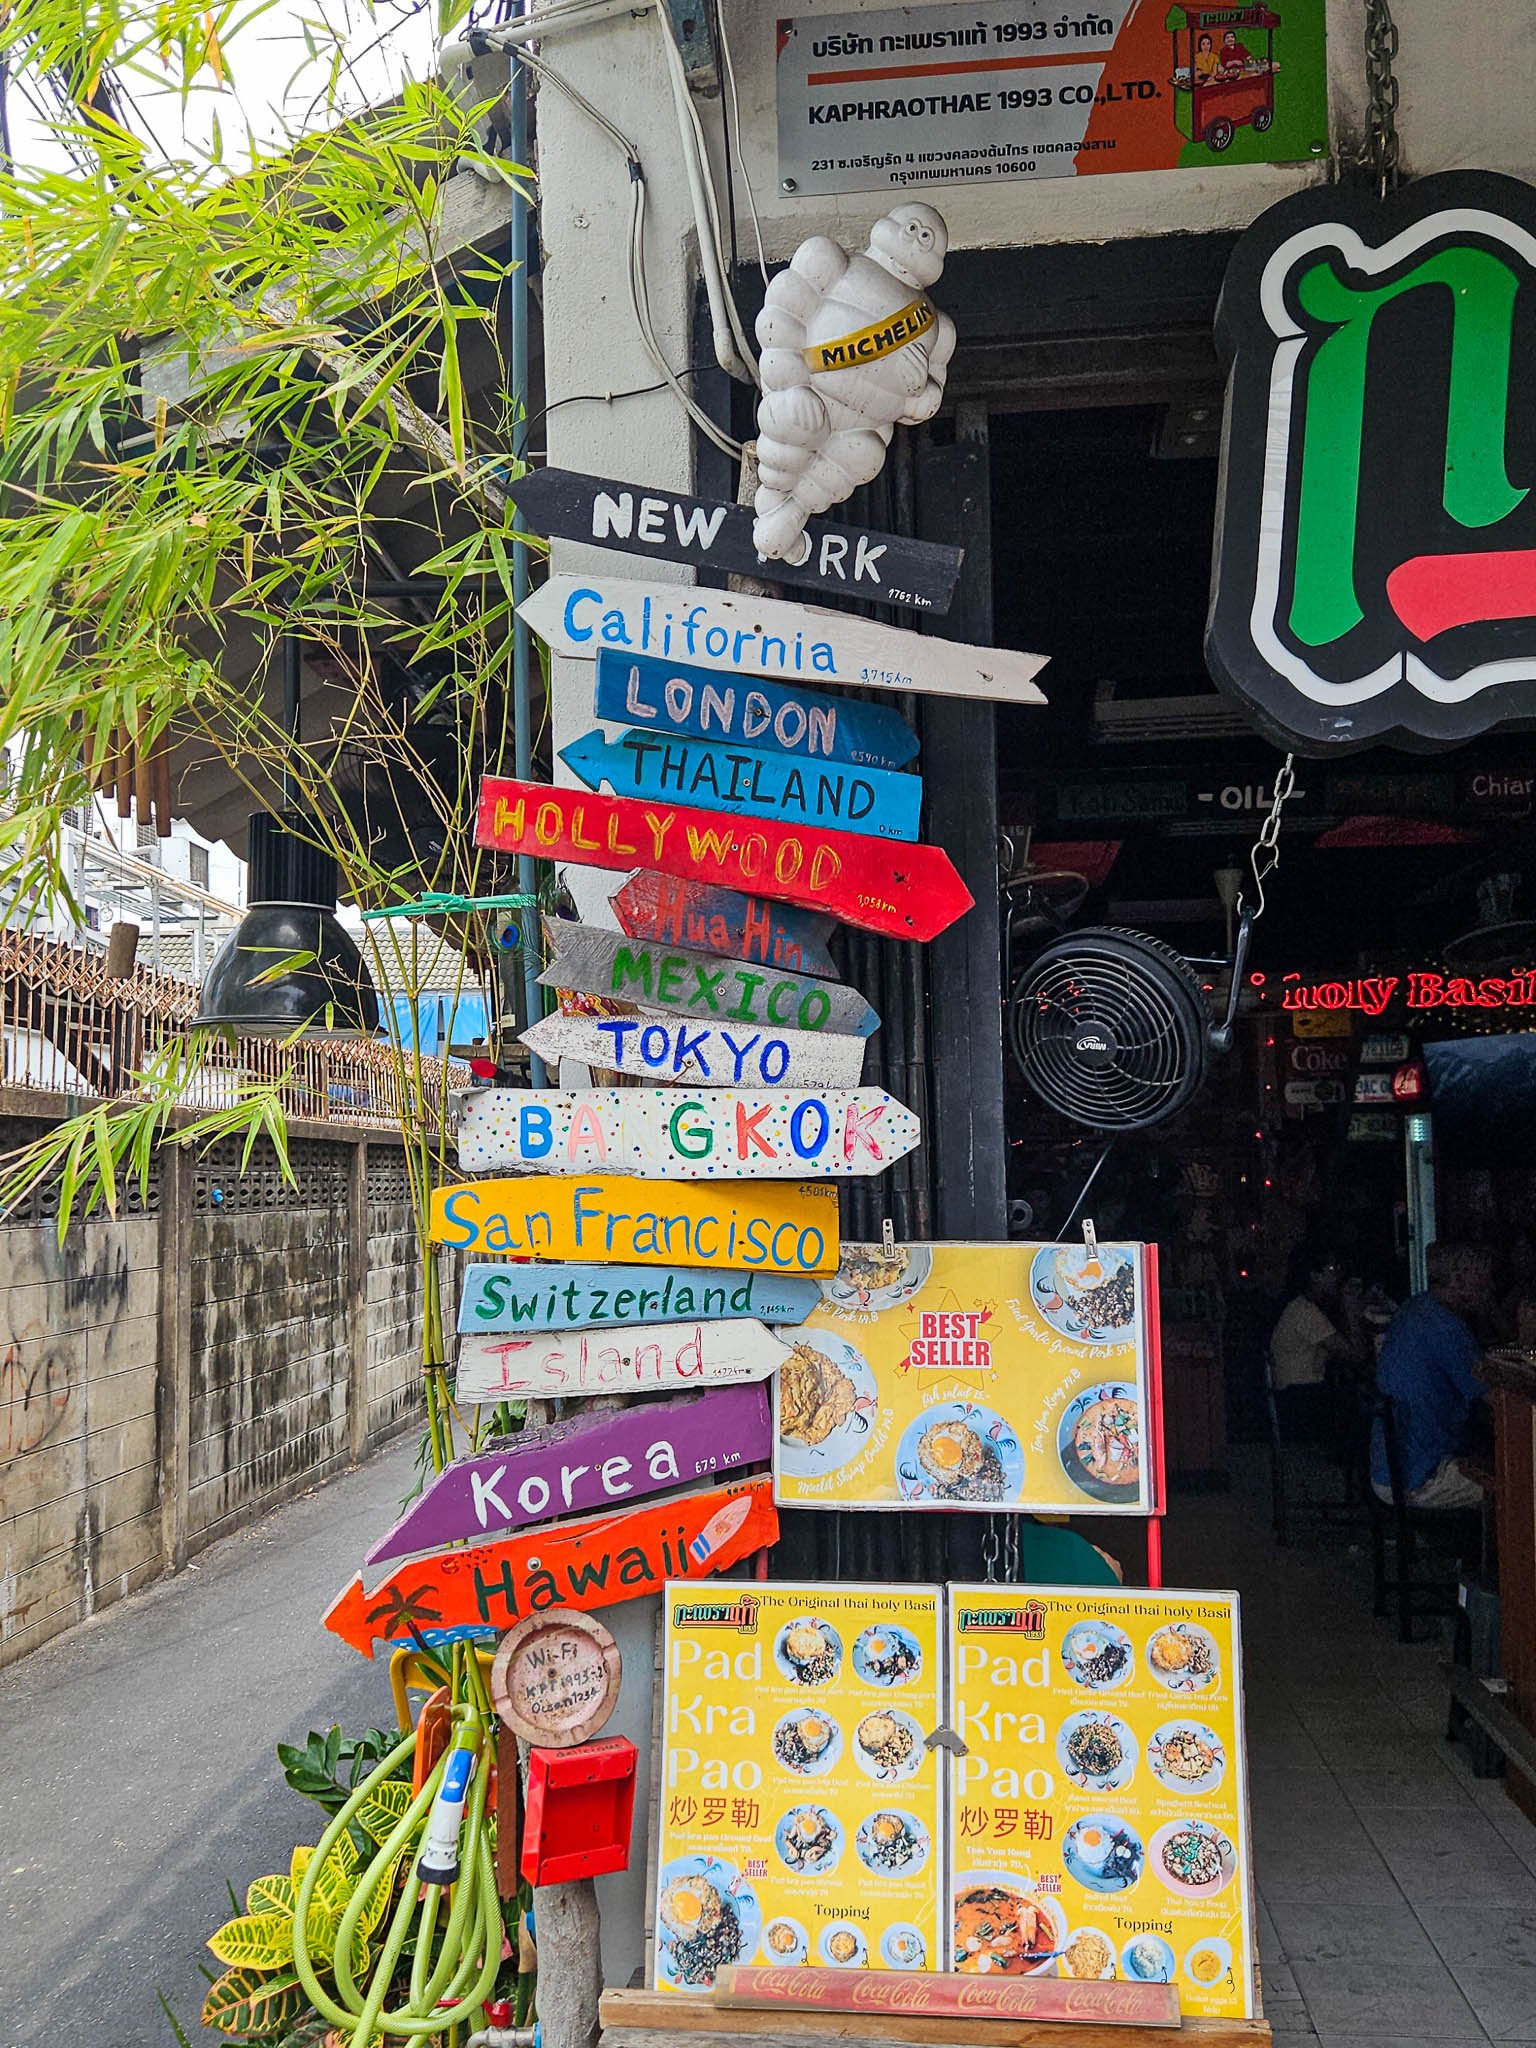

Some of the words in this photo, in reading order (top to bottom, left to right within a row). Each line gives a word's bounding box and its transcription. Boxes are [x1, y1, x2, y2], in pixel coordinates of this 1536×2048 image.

[813, 32, 873, 57] บริษัท
[879, 21, 988, 52] กะเพราแท้
[992, 21, 1048, 43] 1993
[1053, 14, 1114, 39] จำกัด
[807, 92, 993, 125] KAPHRAOTHAE
[997, 87, 1053, 110] 1993
[811, 159, 835, 171] 231
[905, 153, 915, 164] 4
[889, 164, 992, 185] กรุงเทพมหานคร
[996, 160, 1037, 174] 10600
[820, 303, 933, 367] MICHELIN
[592, 491, 727, 550] NEW
[563, 588, 838, 674] California
[626, 665, 837, 755] LONDON
[623, 740, 876, 820] THAILAND
[493, 797, 842, 892] HOLLYWOOD
[887, 825, 904, 836] km
[654, 884, 731, 948] Hua
[611, 947, 831, 1031] MEXICO
[596, 1020, 791, 1085] TOKYO
[441, 1190, 553, 1251] San
[573, 1186, 825, 1269] Francisco
[475, 1272, 755, 1323] Switzerland
[922, 1312, 981, 1339] BEST
[480, 1327, 704, 1393] Island
[910, 1340, 991, 1367] SELLER
[470, 1440, 681, 1528] Korea
[695, 1456, 717, 1474] 679
[723, 1452, 741, 1465] km
[473, 1526, 690, 1624] Hawaii
[760, 1595, 785, 1608] The
[789, 1595, 840, 1610] Original
[872, 1598, 899, 1612] holy
[904, 1598, 936, 1611] Basil
[1047, 1600, 1073, 1614] The
[1077, 1601, 1130, 1615] Original
[1164, 1604, 1193, 1617] holy
[1197, 1606, 1231, 1619] Basil
[525, 1642, 578, 1669] Wi-Fi
[671, 1639, 762, 1681] Pad
[957, 1644, 1049, 1688] Pad
[669, 1693, 755, 1736] Kra
[957, 1700, 1046, 1744] Kra
[668, 1747, 762, 1790] Pao
[957, 1755, 1055, 1800] Pao
[669, 1794, 760, 1829] 炒罗勒
[959, 1805, 1053, 1841] 炒罗勒
[744, 1869, 768, 1877] SELLER
[747, 1859, 765, 1868] BEST
[1040, 1874, 1058, 1883] BEST
[1037, 1883, 1062, 1893] SELLER
[814, 1903, 870, 1920] Topping
[1114, 1916, 1173, 1934] Topping
